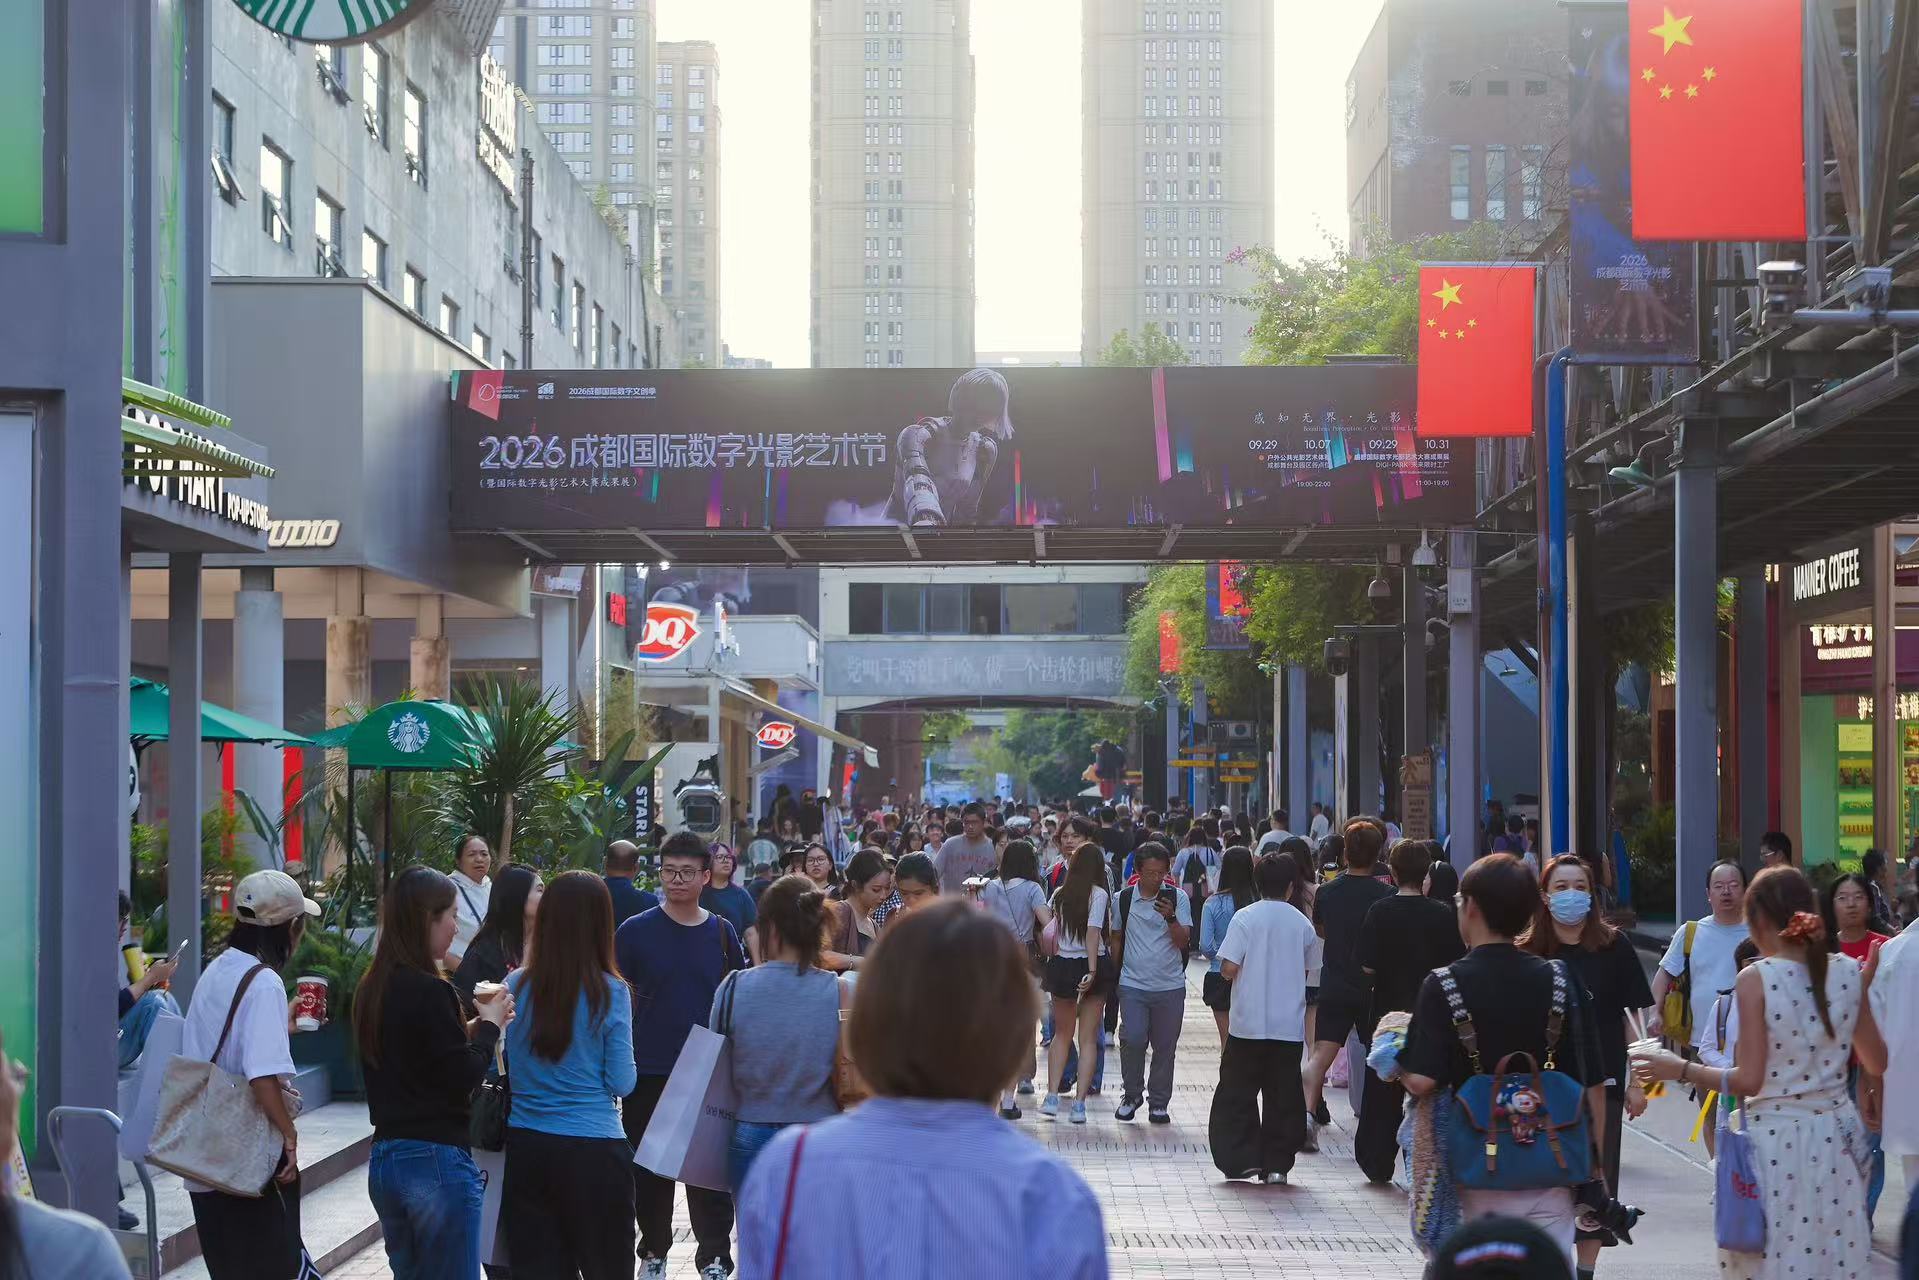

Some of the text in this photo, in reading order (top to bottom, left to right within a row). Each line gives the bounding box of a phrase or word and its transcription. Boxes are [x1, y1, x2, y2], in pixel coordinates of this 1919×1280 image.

[1249, 439, 1331, 450] 09.29 10.07
[1369, 439, 1450, 449] 09.29 10.31
[267, 519, 342, 547] UDIO
[1793, 558, 1827, 602] MANNER
[1828, 548, 1860, 592] COFFEE
[764, 726, 793, 743] DQ
